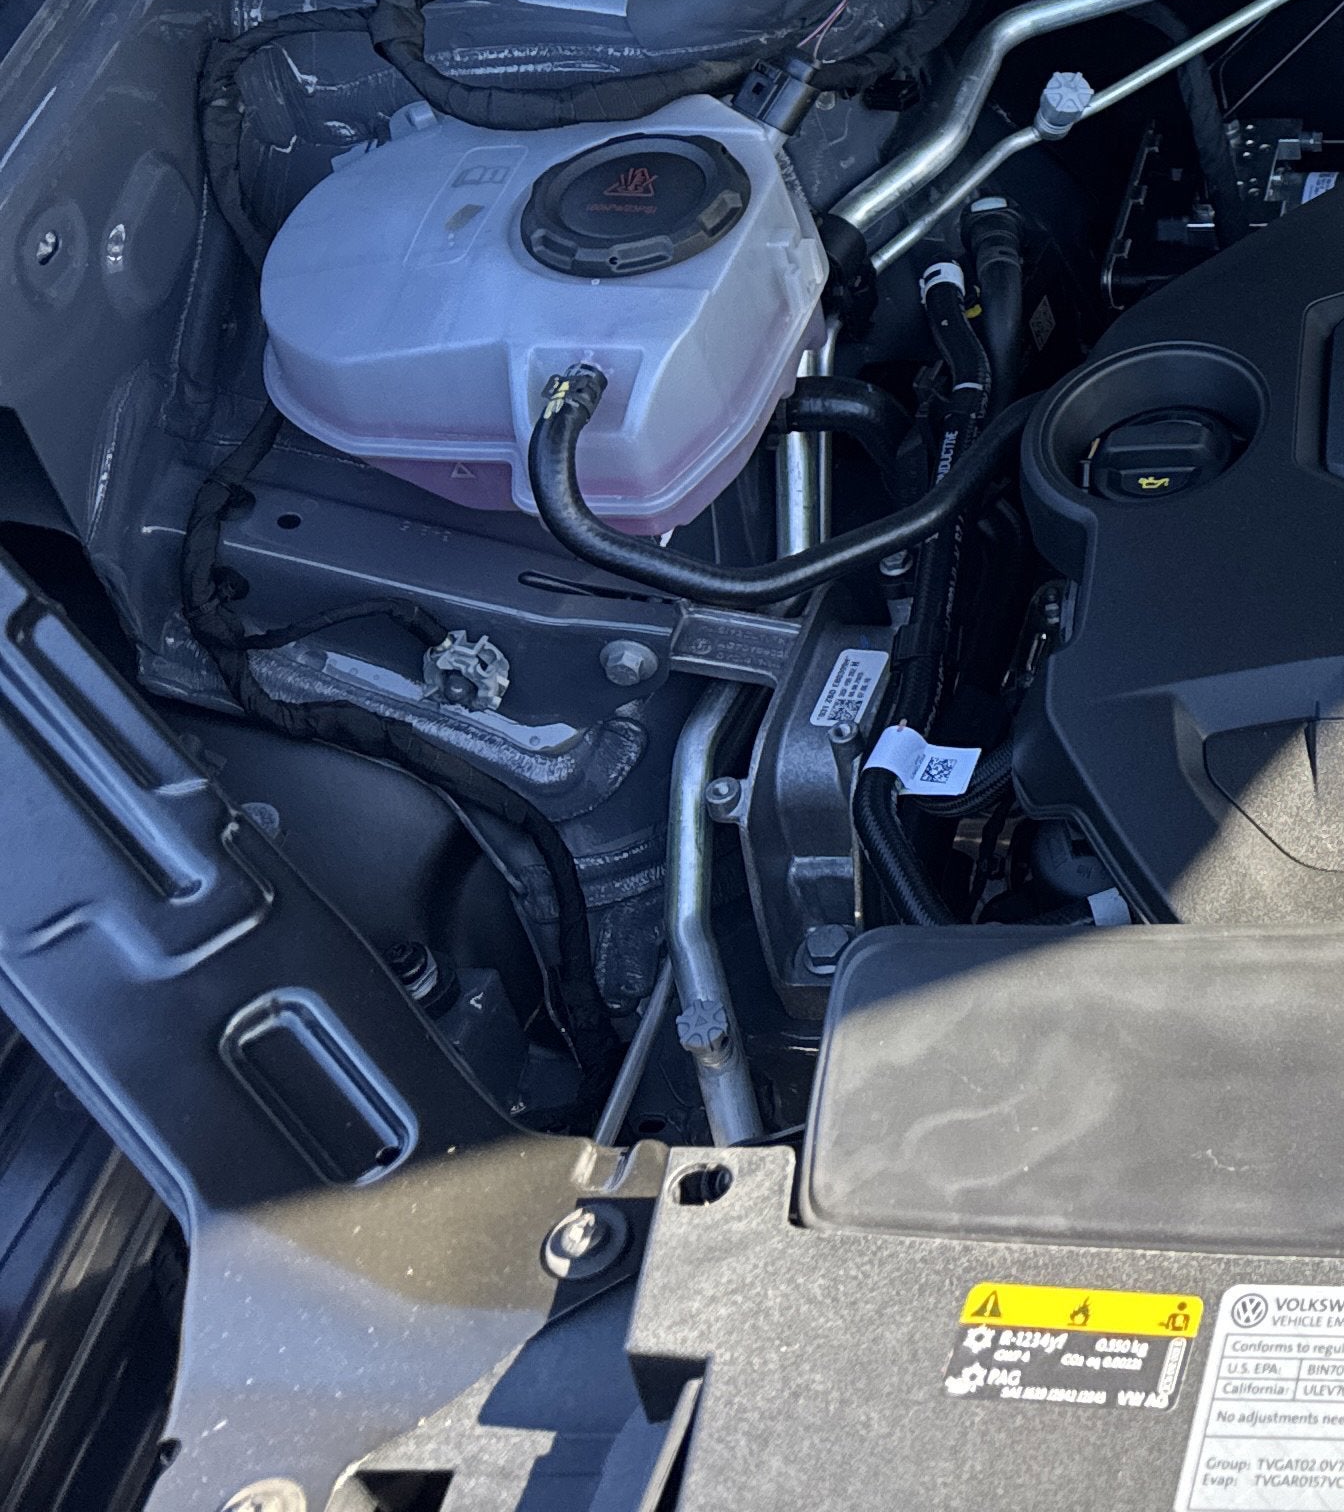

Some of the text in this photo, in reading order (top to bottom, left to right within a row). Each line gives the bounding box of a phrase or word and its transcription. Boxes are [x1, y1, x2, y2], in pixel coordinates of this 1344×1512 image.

[1272, 1315, 1322, 1327] VEHICLE
[1132, 1340, 1149, 1358] kg
[1232, 1340, 1293, 1353] Conforms
[1297, 1341, 1309, 1353] to
[1227, 1363, 1250, 1374] U.S.
[1307, 1365, 1344, 1376] BIN70
[987, 1369, 1022, 1386] PAG
[1117, 1390, 1169, 1408] VW AG
[1217, 1410, 1235, 1422] No
[1238, 1412, 1318, 1427] adjustments
[1206, 1456, 1251, 1472] Group:
[1202, 1474, 1238, 1489] Evap:
